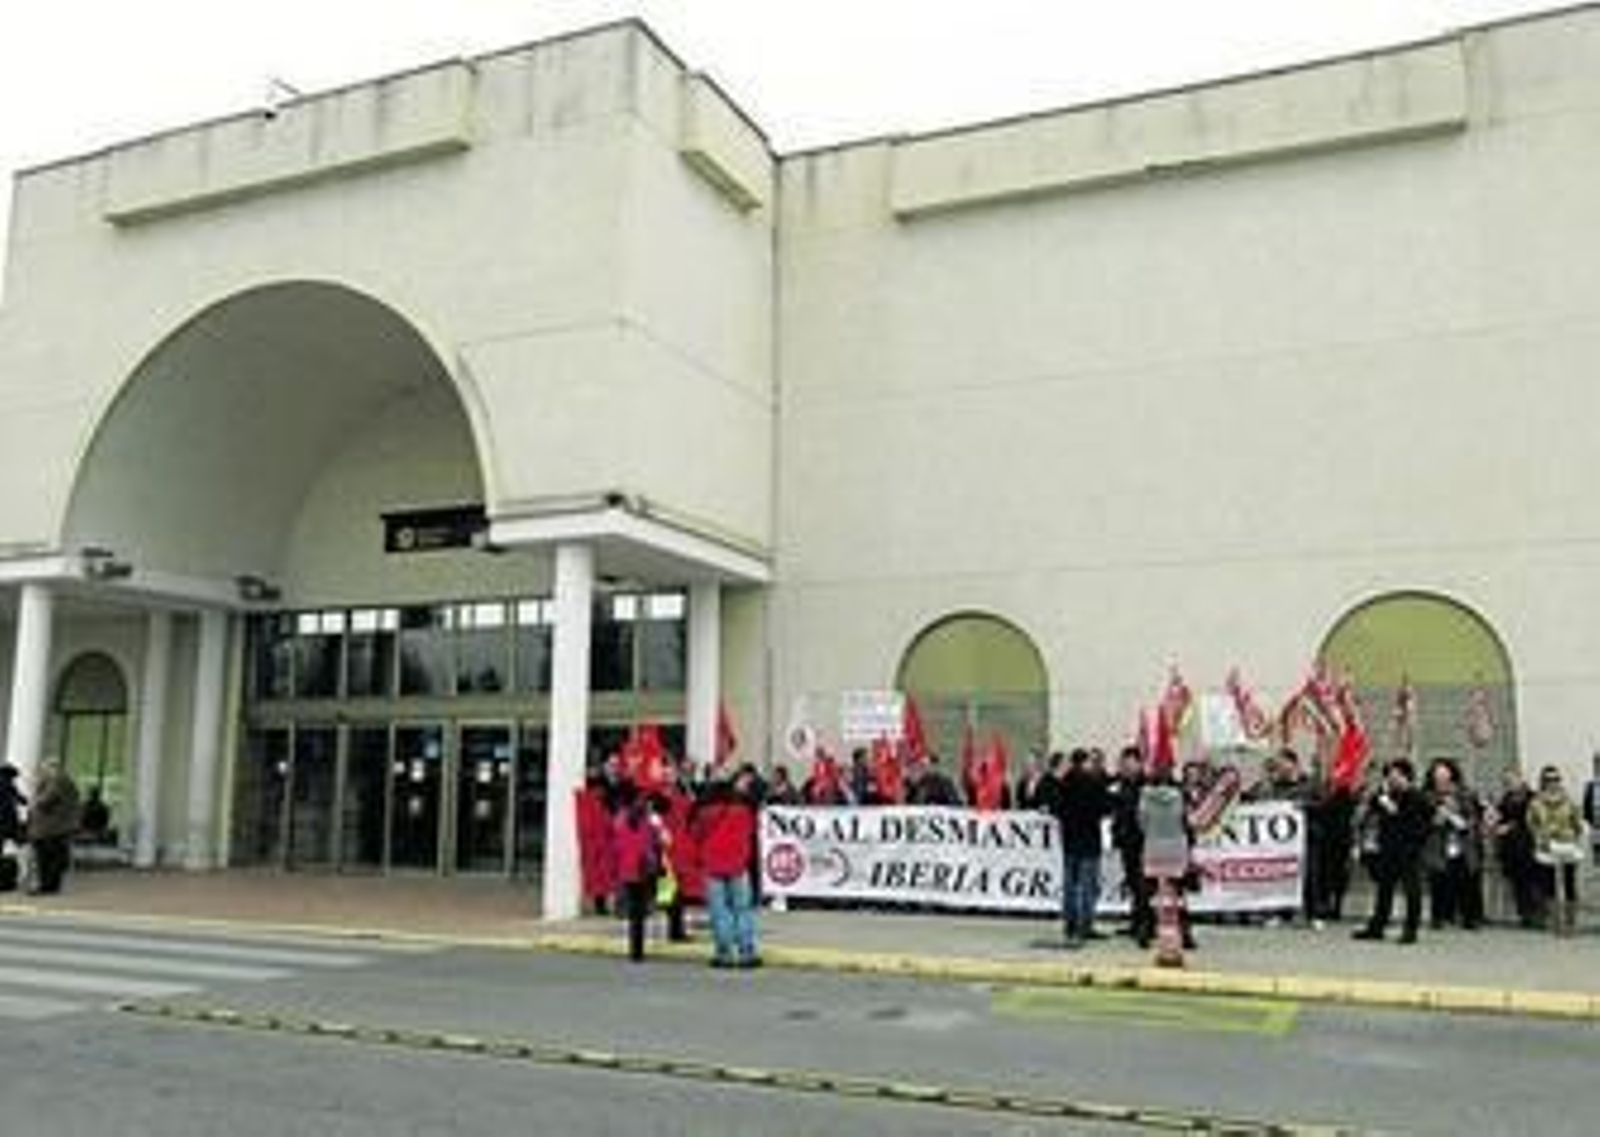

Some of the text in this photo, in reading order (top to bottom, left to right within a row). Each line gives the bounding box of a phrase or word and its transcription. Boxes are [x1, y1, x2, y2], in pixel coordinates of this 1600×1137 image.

[766, 809, 816, 841] NO
[824, 815, 868, 844] AL
[870, 861, 989, 893] IBERIA
[1000, 866, 1061, 899] GR
